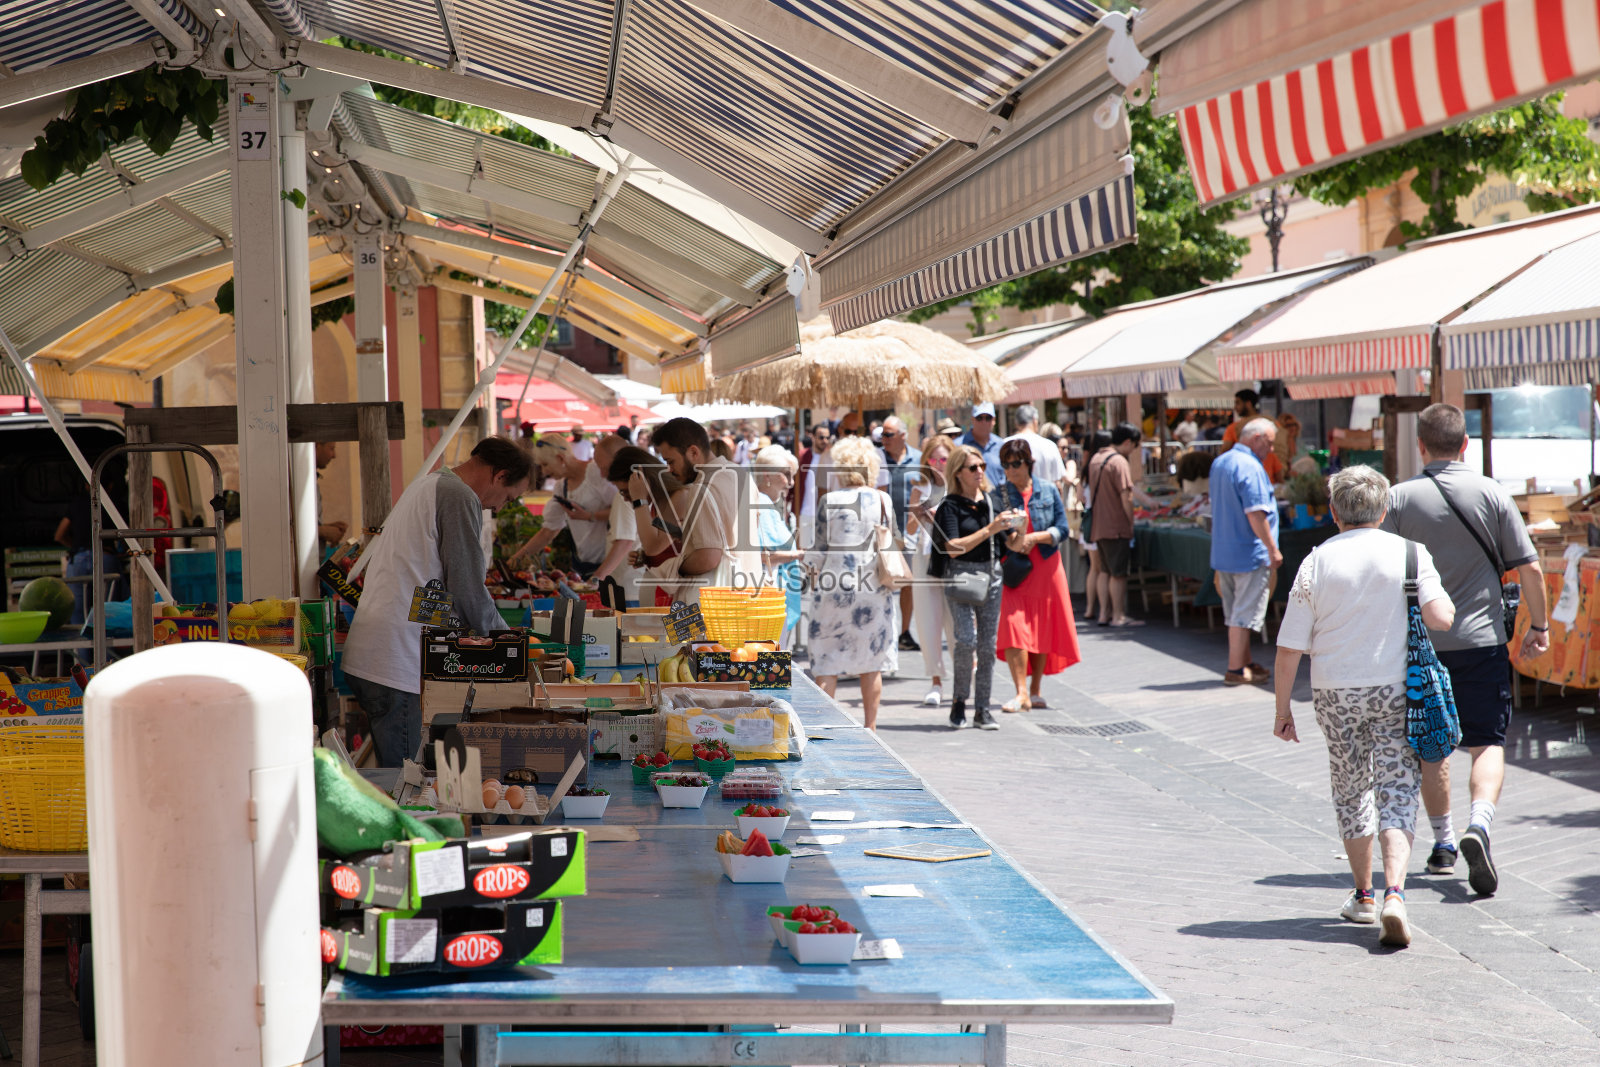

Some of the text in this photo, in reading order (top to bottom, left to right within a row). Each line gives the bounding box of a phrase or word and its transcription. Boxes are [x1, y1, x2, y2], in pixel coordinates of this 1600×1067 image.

[241, 131, 267, 149] 37
[361, 253, 376, 264] 36
[582, 634, 597, 645] Bio
[27, 686, 71, 702] Grappes
[44, 701, 53, 711] de
[331, 867, 360, 893] TROPS
[475, 867, 528, 892] TROPS
[446, 937, 500, 962] TROPS
